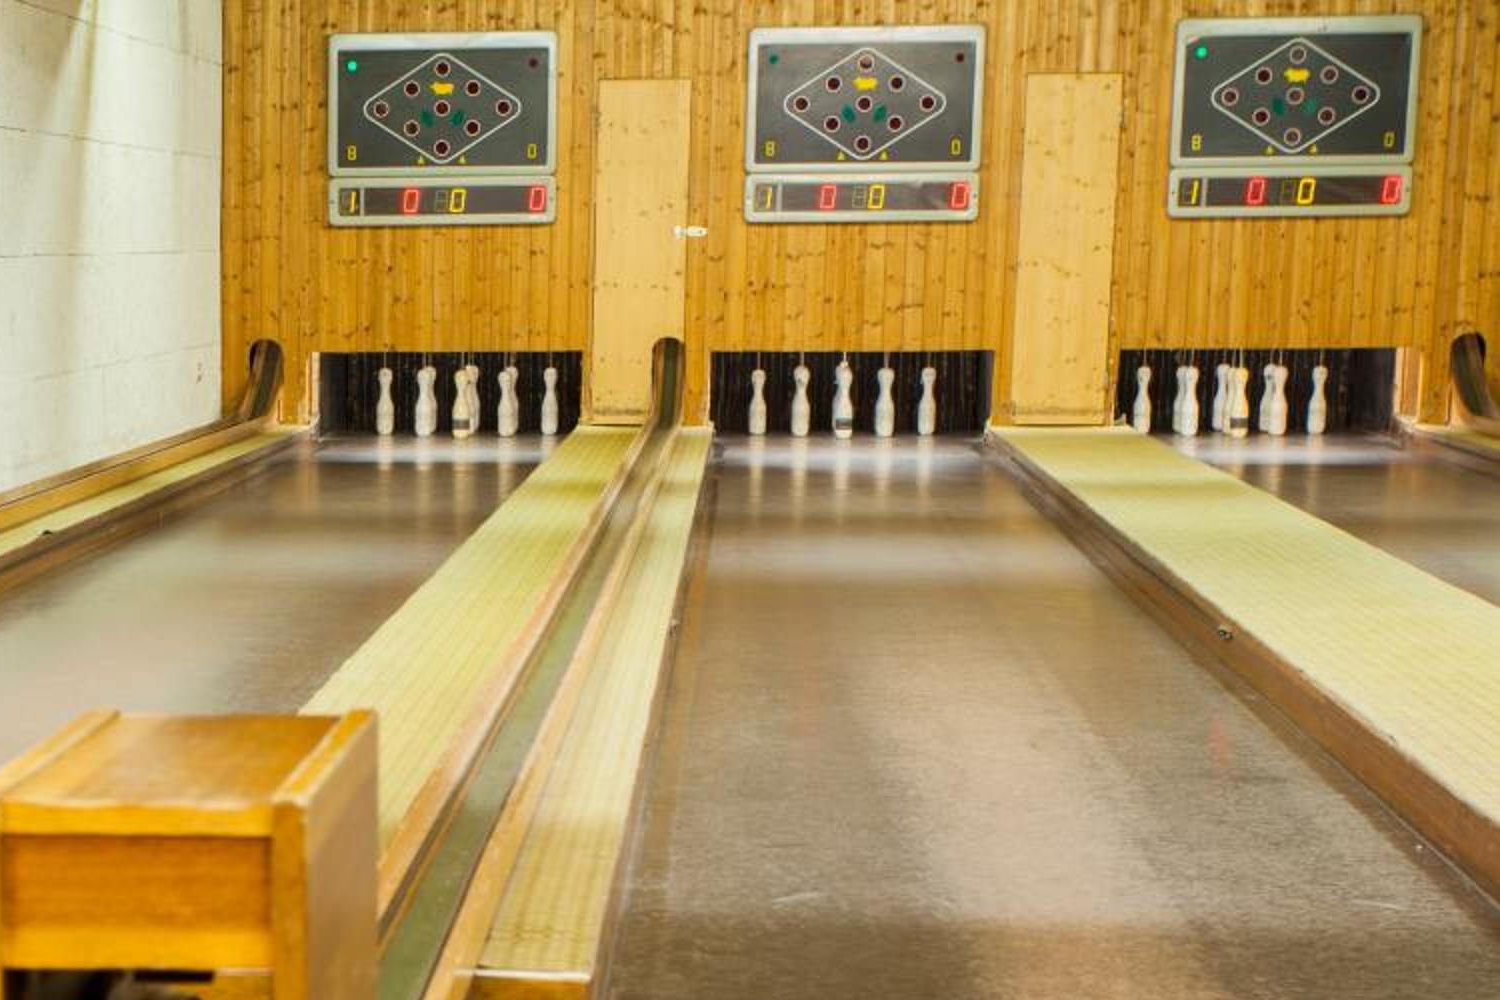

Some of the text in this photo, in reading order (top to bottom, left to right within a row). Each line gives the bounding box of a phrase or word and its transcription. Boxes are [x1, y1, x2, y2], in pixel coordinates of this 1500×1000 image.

[403, 188, 420, 214] 0
[449, 188, 467, 213] 0
[529, 186, 547, 212] 0
[820, 184, 837, 209] 0
[867, 184, 885, 209] 0
[951, 183, 970, 208] 0
[1246, 177, 1266, 204] 0
[1297, 178, 1316, 204] 0
[1381, 176, 1402, 204] 0
